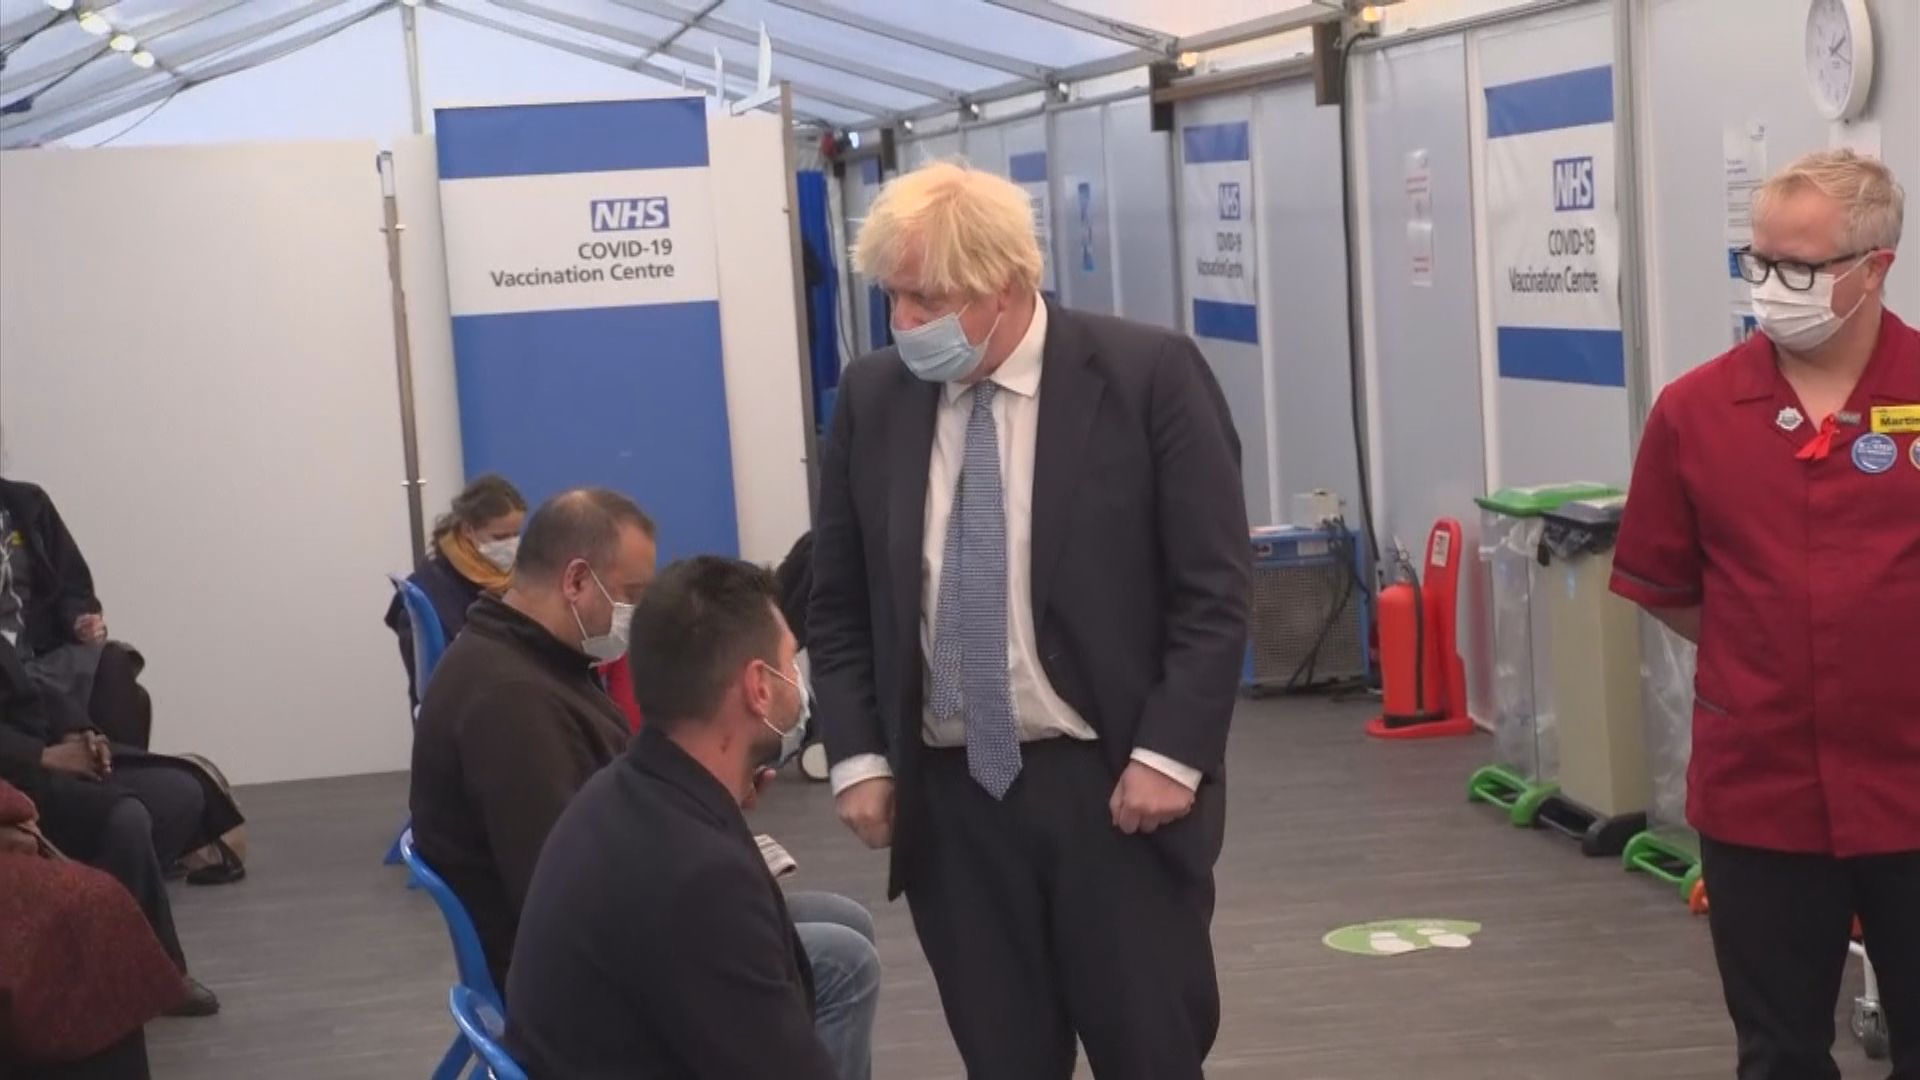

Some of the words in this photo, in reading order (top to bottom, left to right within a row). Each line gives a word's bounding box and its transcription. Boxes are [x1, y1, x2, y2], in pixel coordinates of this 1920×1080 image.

[1555, 160, 1592, 208] NHS
[593, 199, 665, 229] NHS
[1219, 185, 1240, 218] NHS
[577, 239, 673, 260] COVID-19
[1548, 227, 1596, 255] COVID-19
[490, 266, 604, 287] Vaccination
[610, 263, 675, 281] Centre
[1509, 266, 1562, 293] Vaccination
[1564, 265, 1598, 293] Centre
